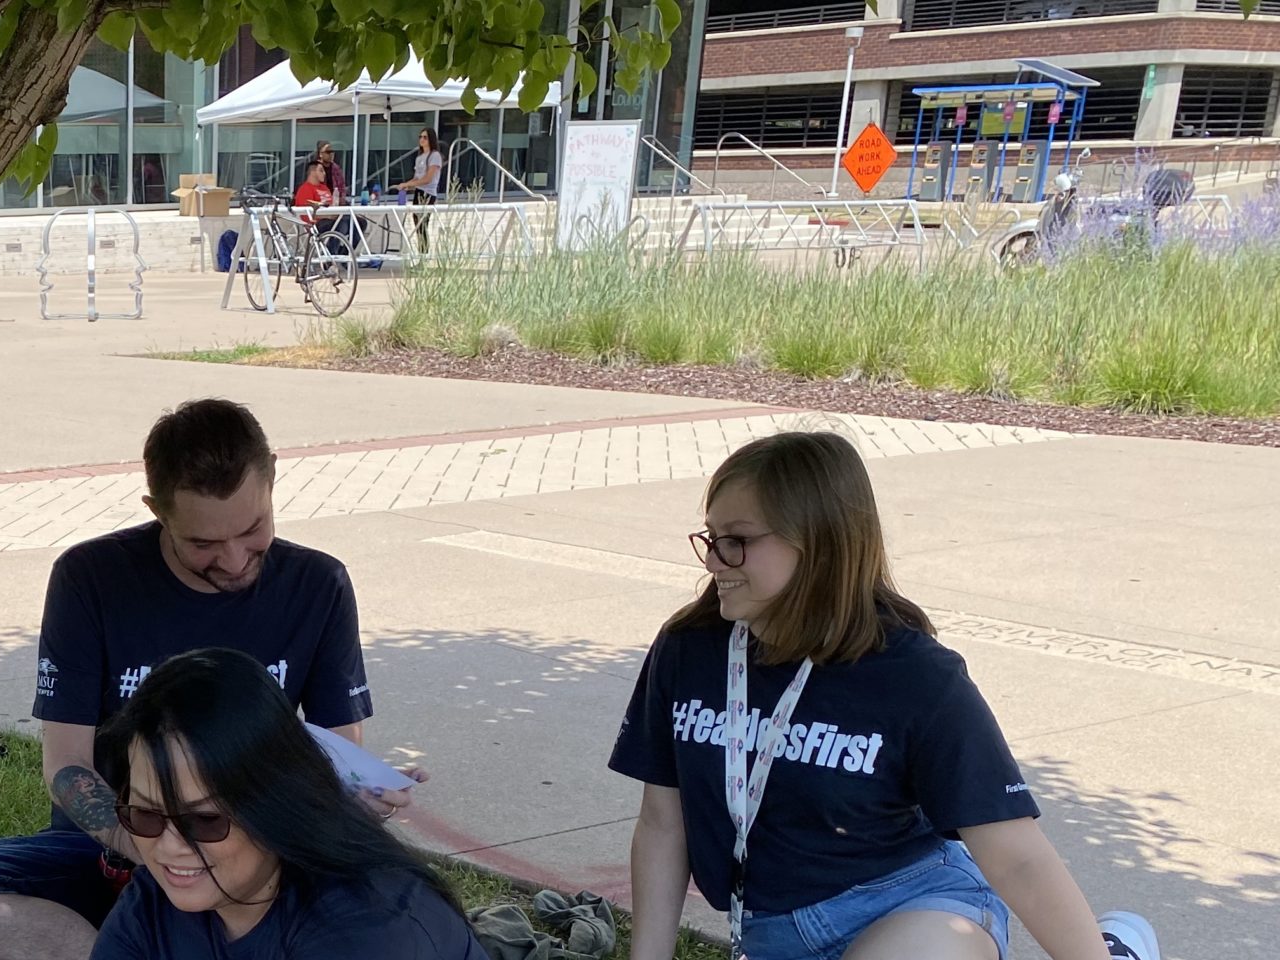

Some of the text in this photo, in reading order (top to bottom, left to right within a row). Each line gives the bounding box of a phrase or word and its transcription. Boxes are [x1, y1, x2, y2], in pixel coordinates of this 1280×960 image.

[859, 138, 882, 149] ROAD
[858, 151, 881, 162] WORK
[856, 165, 882, 176] AHEAD
[950, 619, 1110, 651] DRIVER
[1119, 648, 1185, 663] OF
[1065, 648, 1163, 670] VINCI
